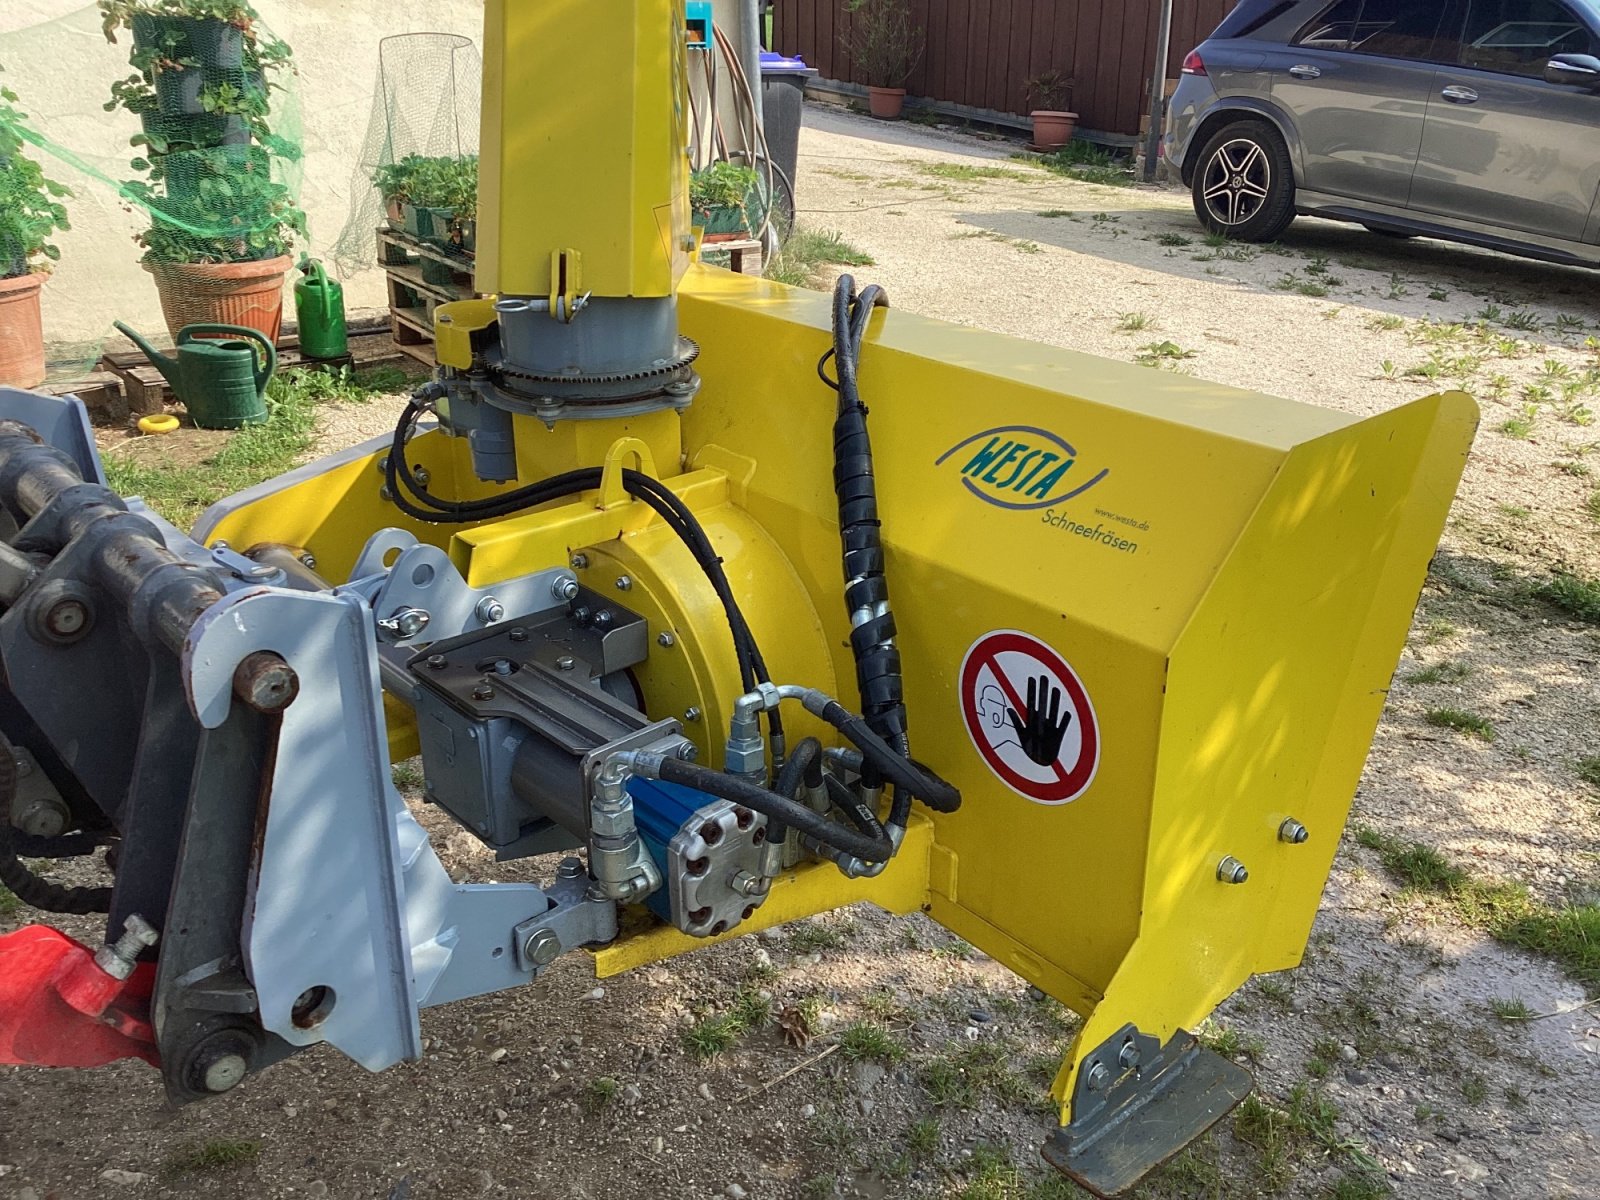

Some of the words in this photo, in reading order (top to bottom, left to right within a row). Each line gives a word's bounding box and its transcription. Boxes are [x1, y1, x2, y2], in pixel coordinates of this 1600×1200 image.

[961, 437, 1075, 499] WESTA
[1041, 508, 1138, 554] Schneefräsen
[1094, 508, 1150, 531] www.westa.de
